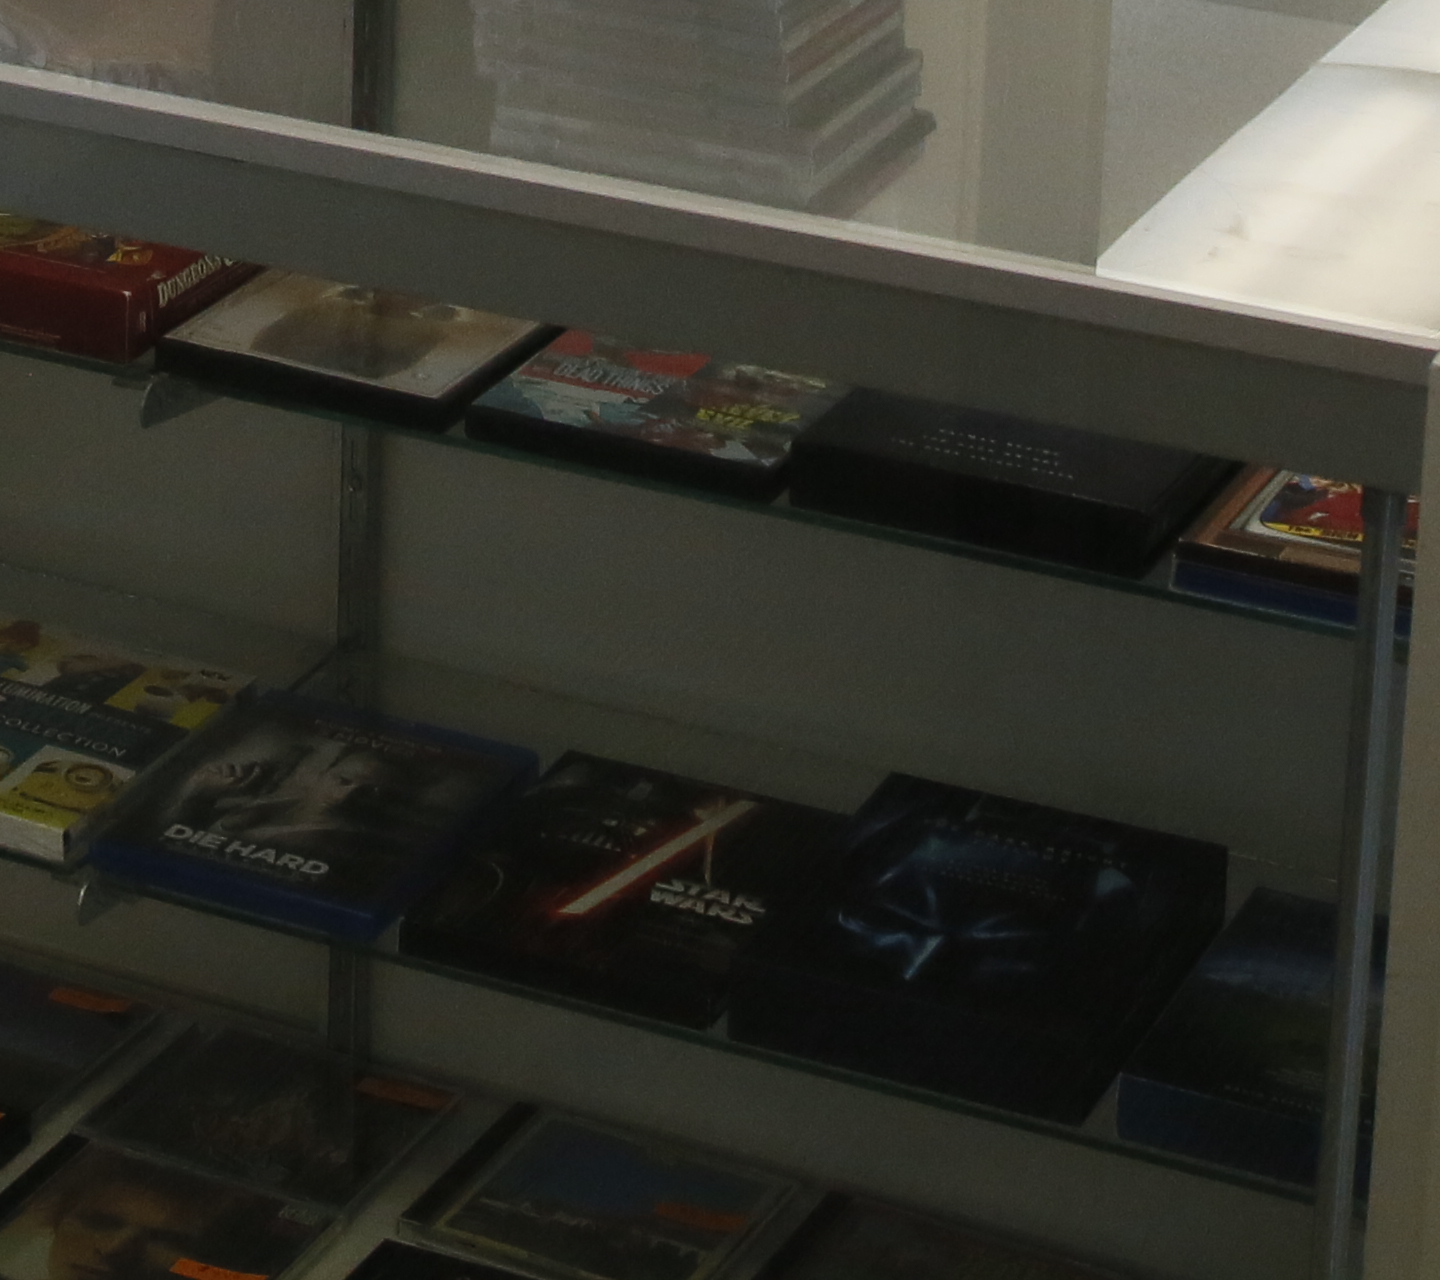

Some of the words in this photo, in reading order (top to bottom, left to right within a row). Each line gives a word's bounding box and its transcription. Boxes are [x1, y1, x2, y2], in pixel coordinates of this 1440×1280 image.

[163, 823, 228, 849] DIE
[225, 840, 330, 876] HARD
[649, 887, 753, 926] WARS
[654, 878, 767, 913] STAR
